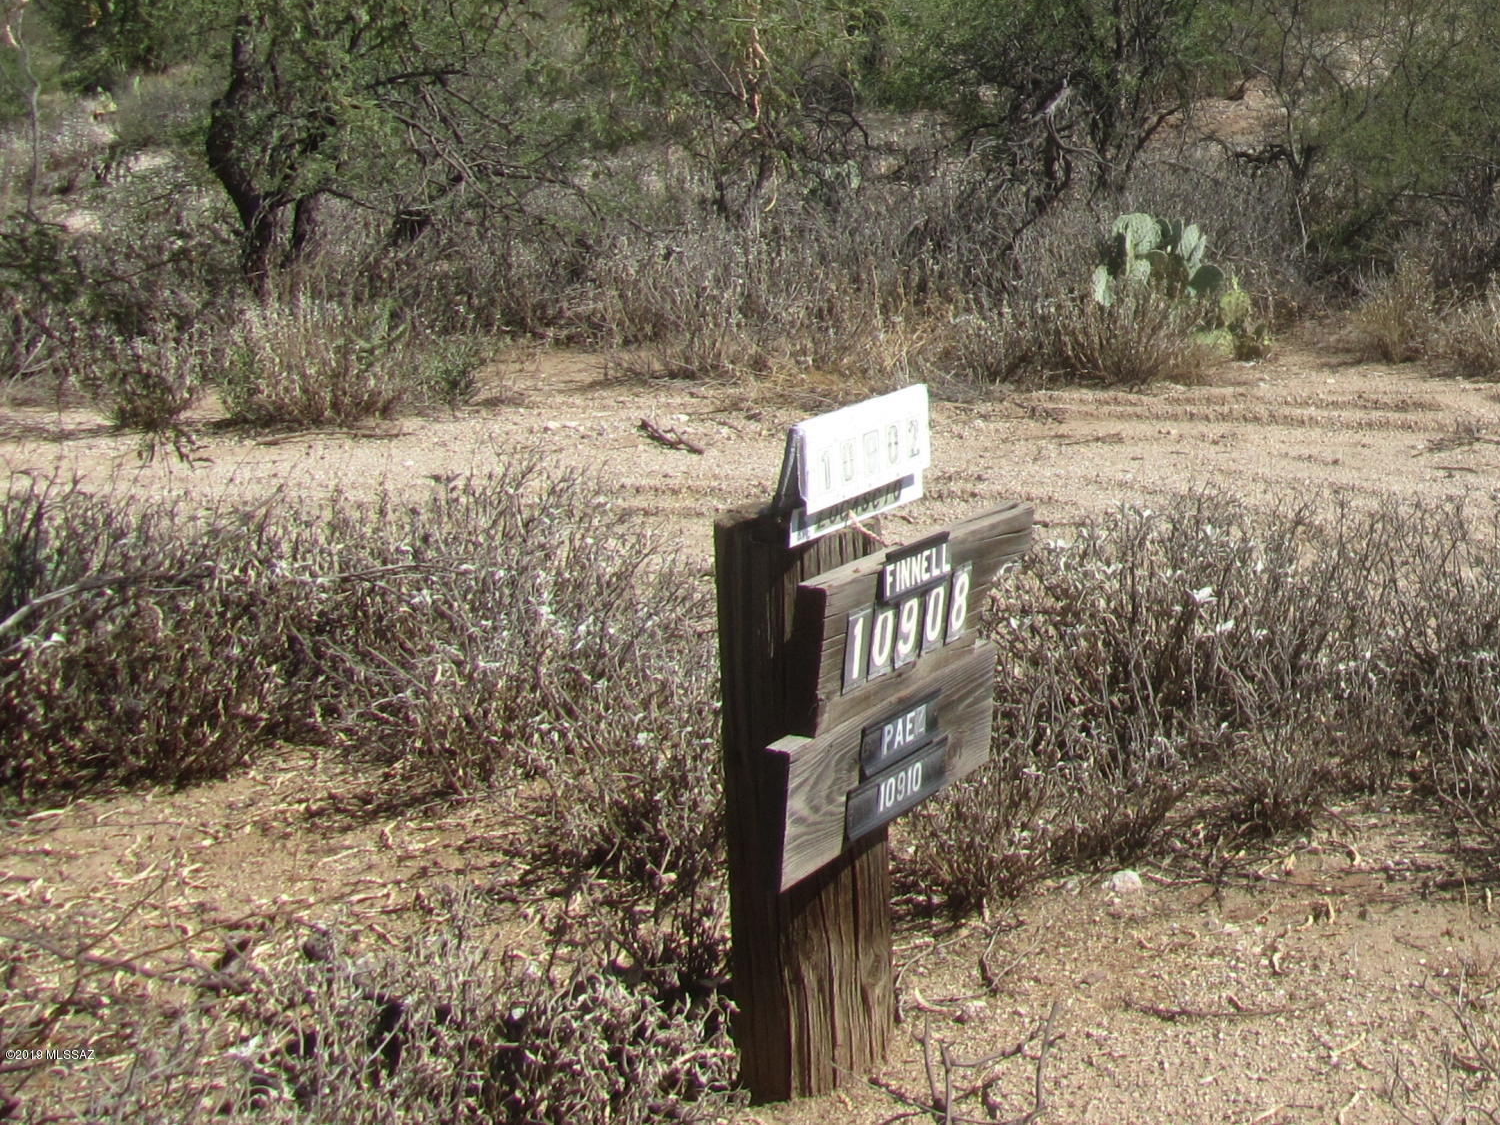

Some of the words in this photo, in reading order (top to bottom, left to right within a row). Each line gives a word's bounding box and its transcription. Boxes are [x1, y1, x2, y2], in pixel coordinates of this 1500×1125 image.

[885, 543, 952, 598] FINNELL
[852, 572, 970, 679] 10908
[880, 761, 922, 811] 10910
